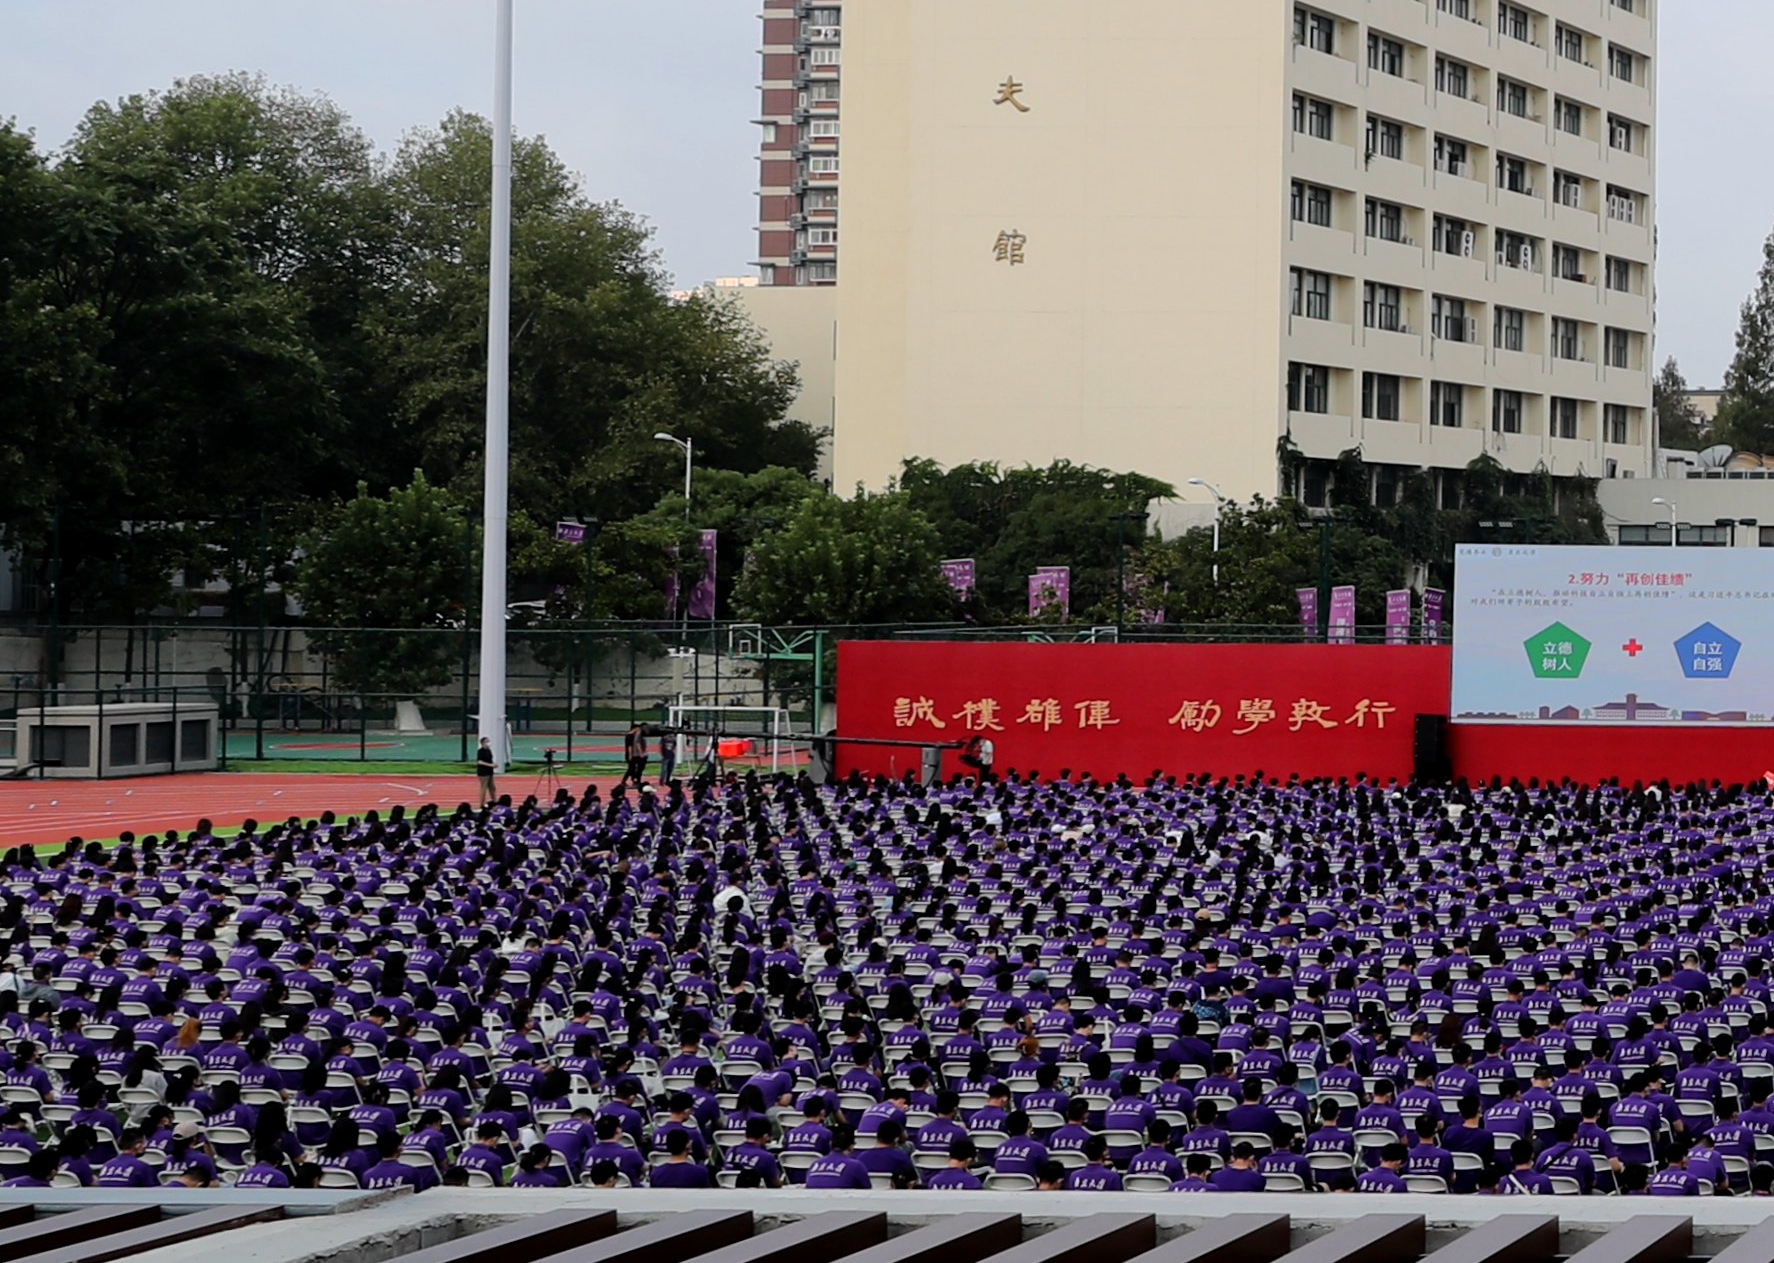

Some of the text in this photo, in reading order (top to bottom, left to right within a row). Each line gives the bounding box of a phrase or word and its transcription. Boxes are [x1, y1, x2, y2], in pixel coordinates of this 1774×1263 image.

[1542, 641, 1573, 656] 立德
[1693, 641, 1723, 656] 自立
[1542, 657, 1573, 672] 树人
[1693, 657, 1723, 672] 自强
